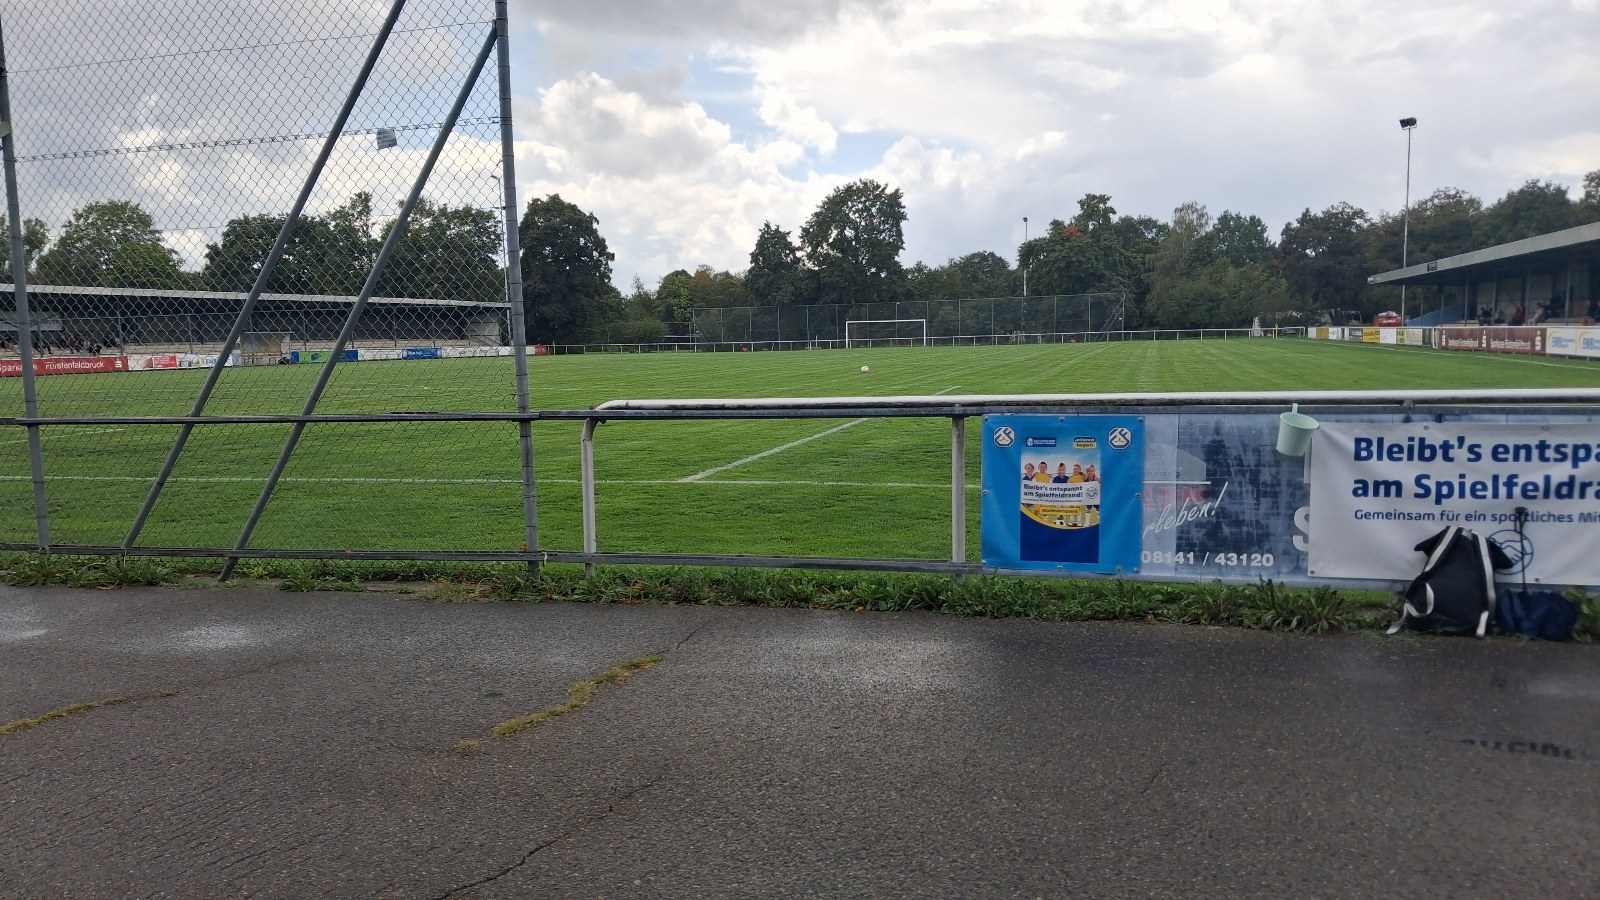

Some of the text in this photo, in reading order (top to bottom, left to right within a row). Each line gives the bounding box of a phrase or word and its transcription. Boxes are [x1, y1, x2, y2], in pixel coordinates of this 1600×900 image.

[1353, 436, 1482, 463] Bleibt's
[1351, 477, 1403, 498] am
[1354, 509, 1435, 522] Gemeinsam
[1439, 509, 1460, 522] für
[1464, 511, 1487, 523] ein
[1141, 551, 1274, 567] 08141 / 43120
